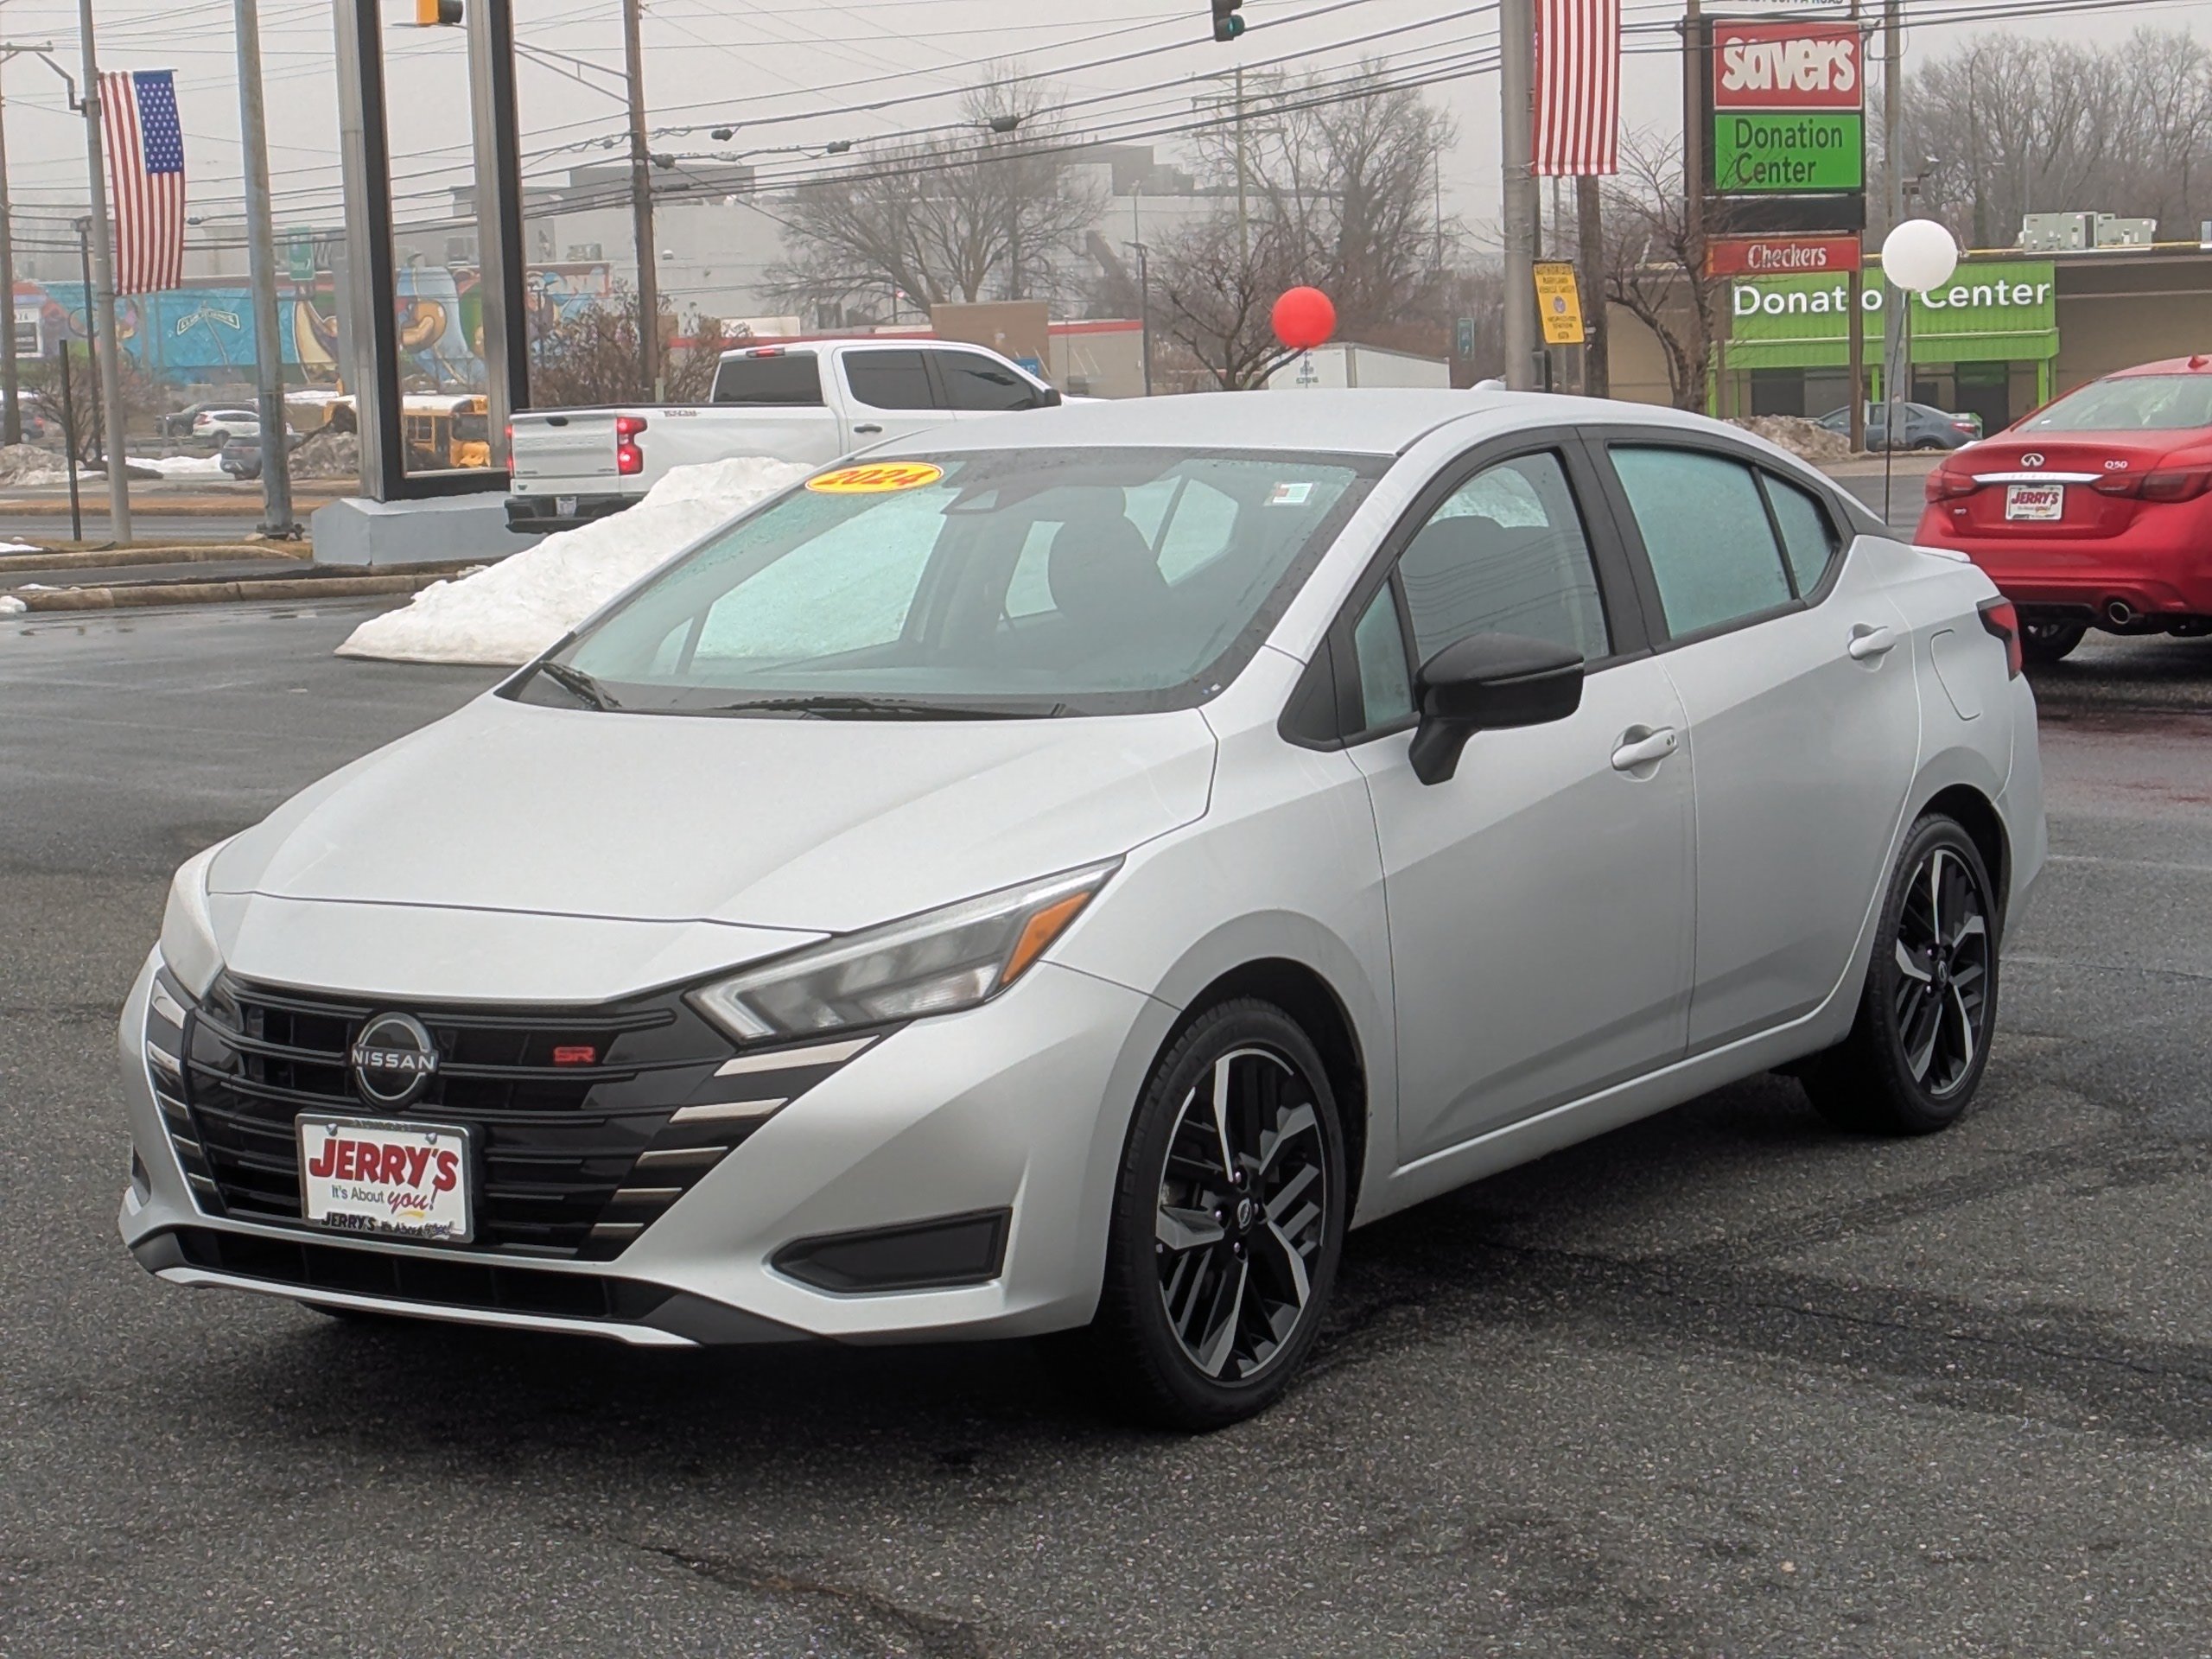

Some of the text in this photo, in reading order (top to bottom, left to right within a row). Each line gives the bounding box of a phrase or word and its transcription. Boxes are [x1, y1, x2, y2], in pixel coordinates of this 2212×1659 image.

[1735, 118, 1843, 149] Donation
[1736, 152, 1816, 183] Center
[1748, 243, 1827, 269] Checkers
[1921, 279, 2050, 309] Center
[813, 469, 935, 486] 2024
[2104, 461, 2128, 470] Q50
[2011, 491, 2060, 505] JERRY'S
[352, 1048, 435, 1071] NISSAN
[554, 1046, 595, 1063] SR
[309, 1138, 459, 1192] JERRY'S
[332, 1184, 436, 1214] It's About you!
[321, 1211, 376, 1231] JERRY'S
